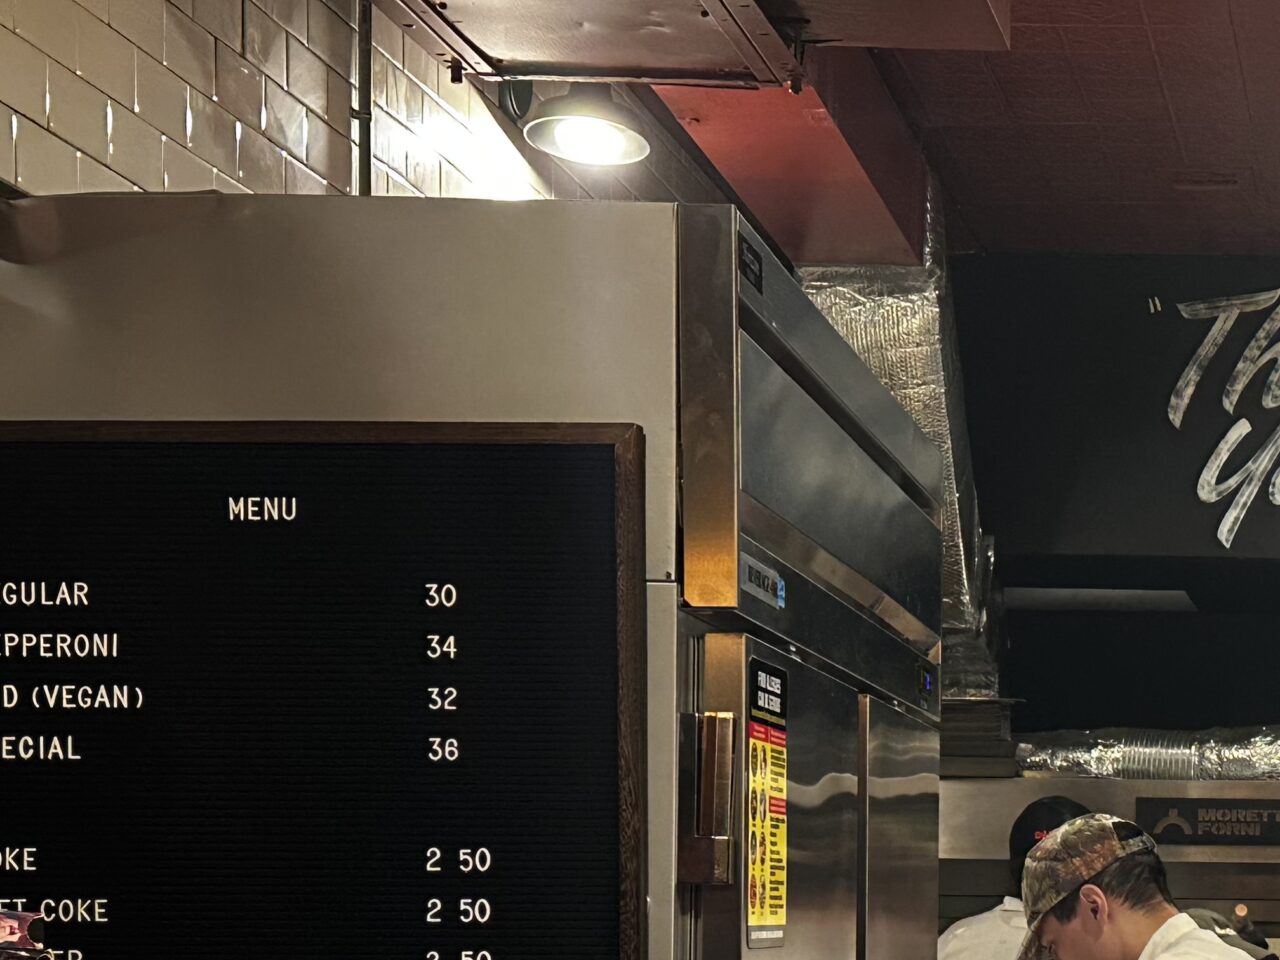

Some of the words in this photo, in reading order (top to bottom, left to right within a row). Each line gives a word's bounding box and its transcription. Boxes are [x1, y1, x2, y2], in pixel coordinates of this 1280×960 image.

[228, 497, 297, 521] MENU
[0, 582, 89, 607] GULAR
[425, 584, 457, 607] 30
[0, 632, 118, 658] PPERONI
[426, 635, 457, 659] 34
[3, 685, 18, 708] D
[32, 684, 143, 709] (VEGAN)
[427, 687, 457, 711] 32
[2, 736, 82, 760] ECIAL
[427, 737, 459, 761] 36
[1198, 822, 1262, 836] FORNI
[0, 847, 37, 871] KE
[426, 847, 442, 872] 2
[459, 848, 491, 872] 50
[41, 899, 109, 923] COKE
[426, 899, 442, 923] 2
[459, 899, 491, 923] 50
